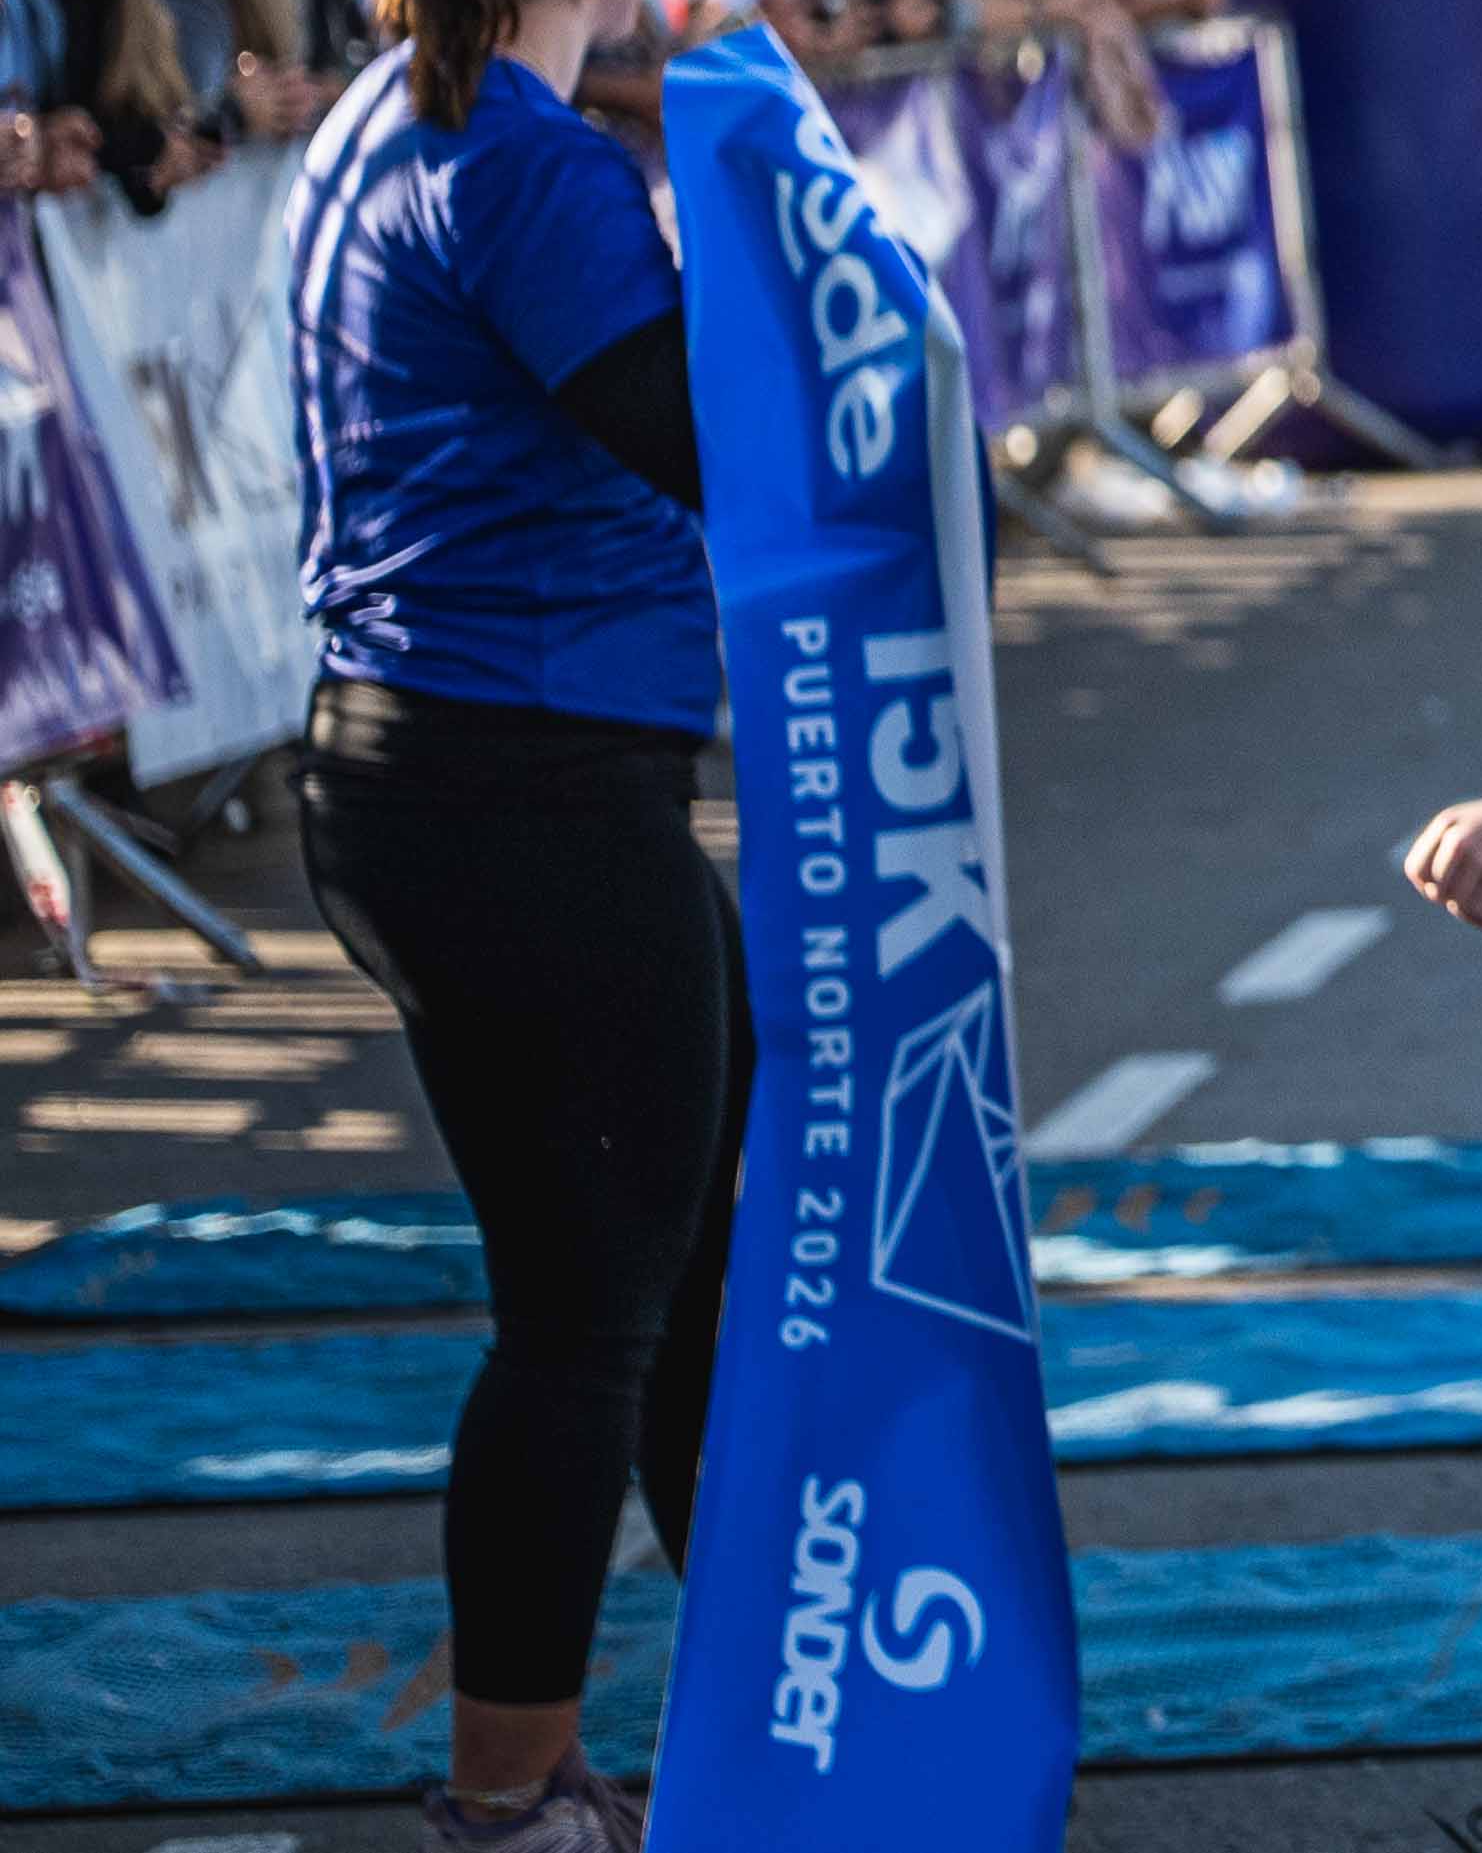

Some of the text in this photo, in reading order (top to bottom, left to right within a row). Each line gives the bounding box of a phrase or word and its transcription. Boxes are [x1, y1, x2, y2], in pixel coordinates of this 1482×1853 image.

[778, 615, 854, 1351] PUERTO NORTE 2026
[862, 630, 1000, 981] 15K
